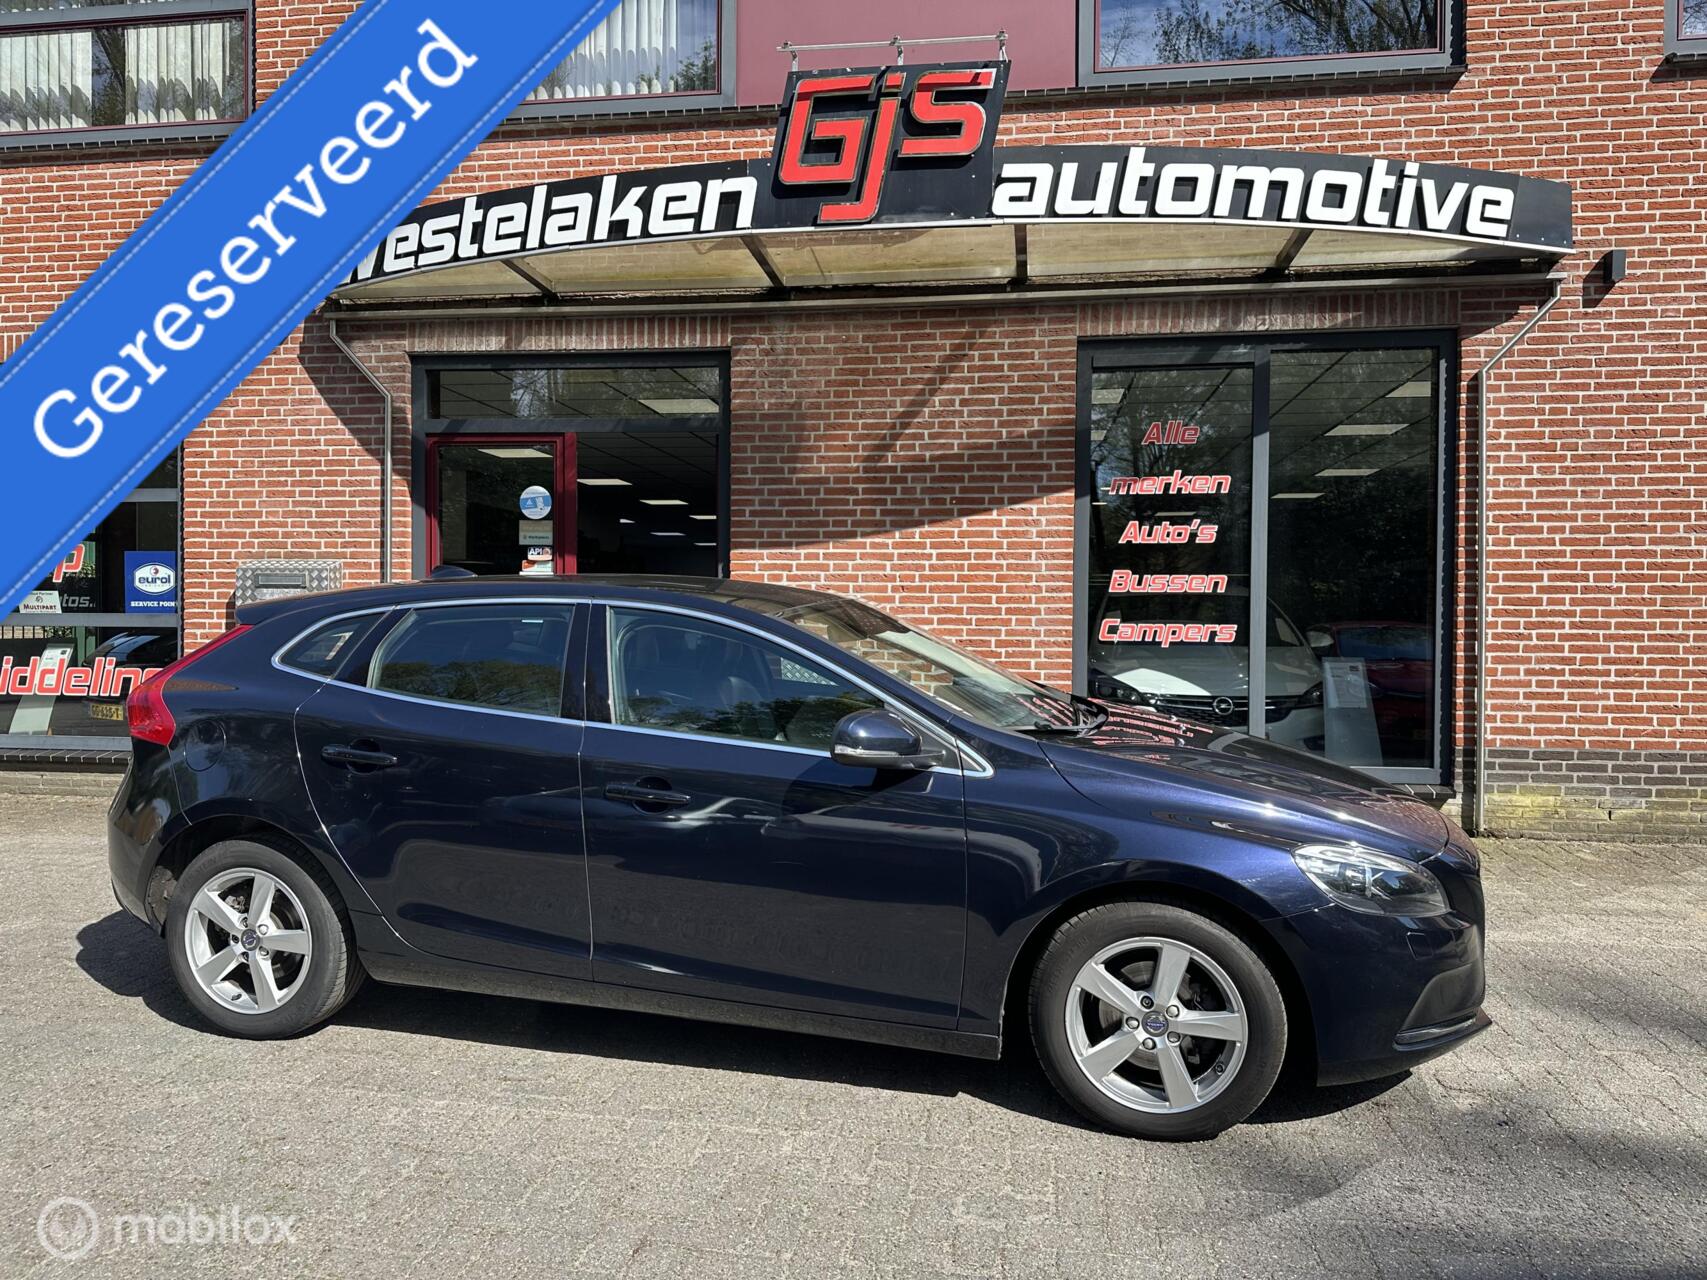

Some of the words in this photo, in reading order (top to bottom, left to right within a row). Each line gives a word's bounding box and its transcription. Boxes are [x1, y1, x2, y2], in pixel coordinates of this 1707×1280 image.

[992, 147, 1515, 238] automotive
[1141, 420, 1199, 445] Alle
[1109, 470, 1231, 494] merken
[1118, 519, 1218, 543] Auto's
[138, 574, 171, 584] eurol
[1109, 569, 1228, 592] Bussen
[1099, 618, 1237, 648] Campers
